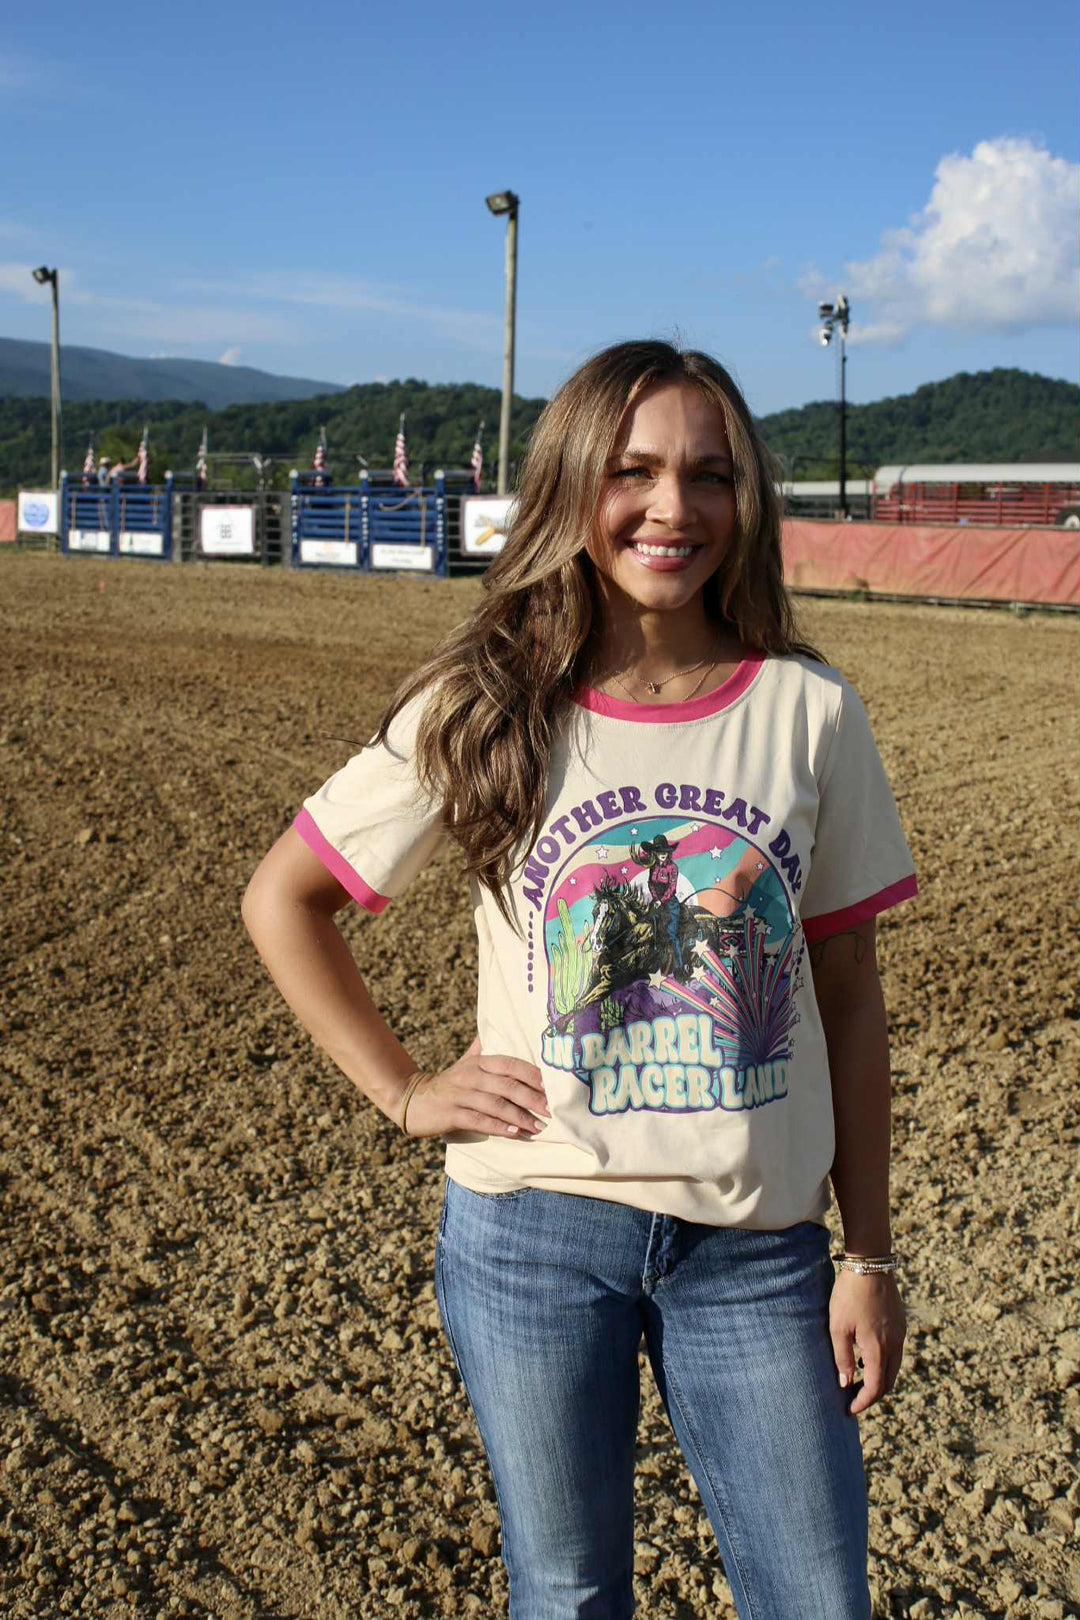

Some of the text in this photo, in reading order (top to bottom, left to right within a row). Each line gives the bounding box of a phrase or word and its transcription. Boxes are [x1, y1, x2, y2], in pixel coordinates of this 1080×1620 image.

[522, 785, 648, 912] ANOTHER
[654, 782, 772, 835] GREAT
[542, 1013, 723, 1071] IN BARREL
[590, 1059, 789, 1114] RACER LAND
